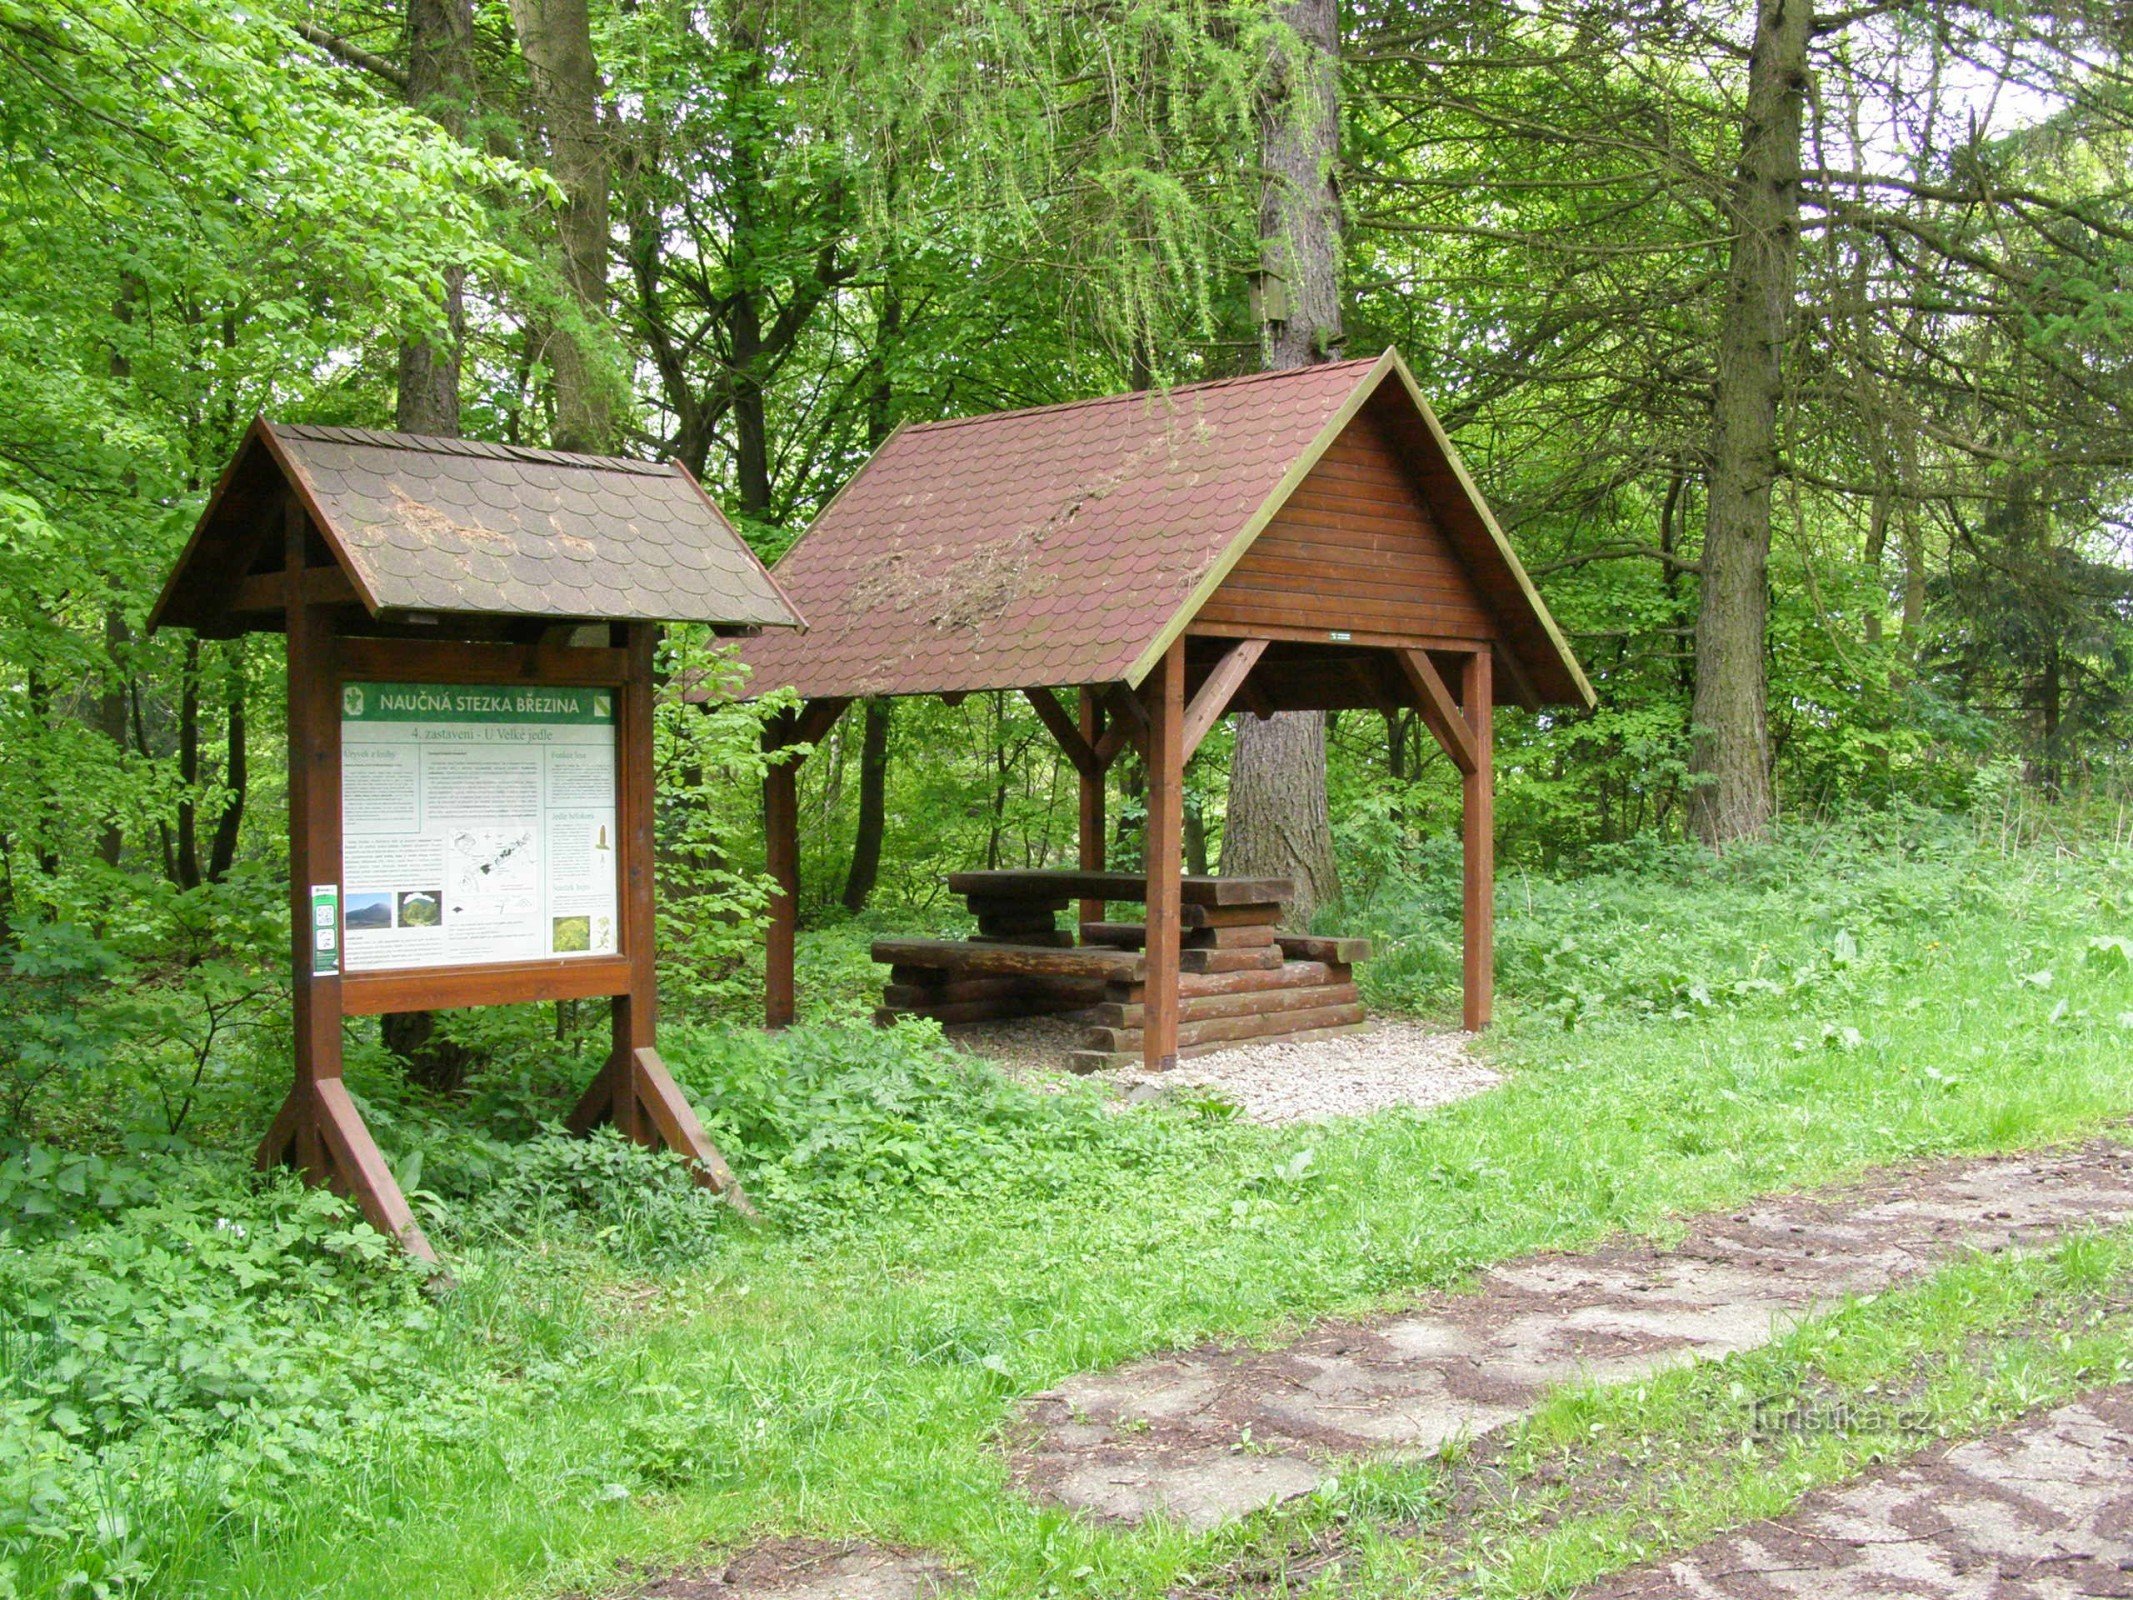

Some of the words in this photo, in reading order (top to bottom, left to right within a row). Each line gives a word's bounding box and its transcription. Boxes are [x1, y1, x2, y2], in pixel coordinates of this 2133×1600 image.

[380, 690, 452, 711] NAUČNÁ
[456, 695, 513, 712] STEZKA
[516, 691, 580, 713] BŘEZINA
[410, 728, 421, 740] 4.
[484, 728, 494, 740] U
[496, 728, 526, 740] Velké
[528, 728, 553, 744] jedle
